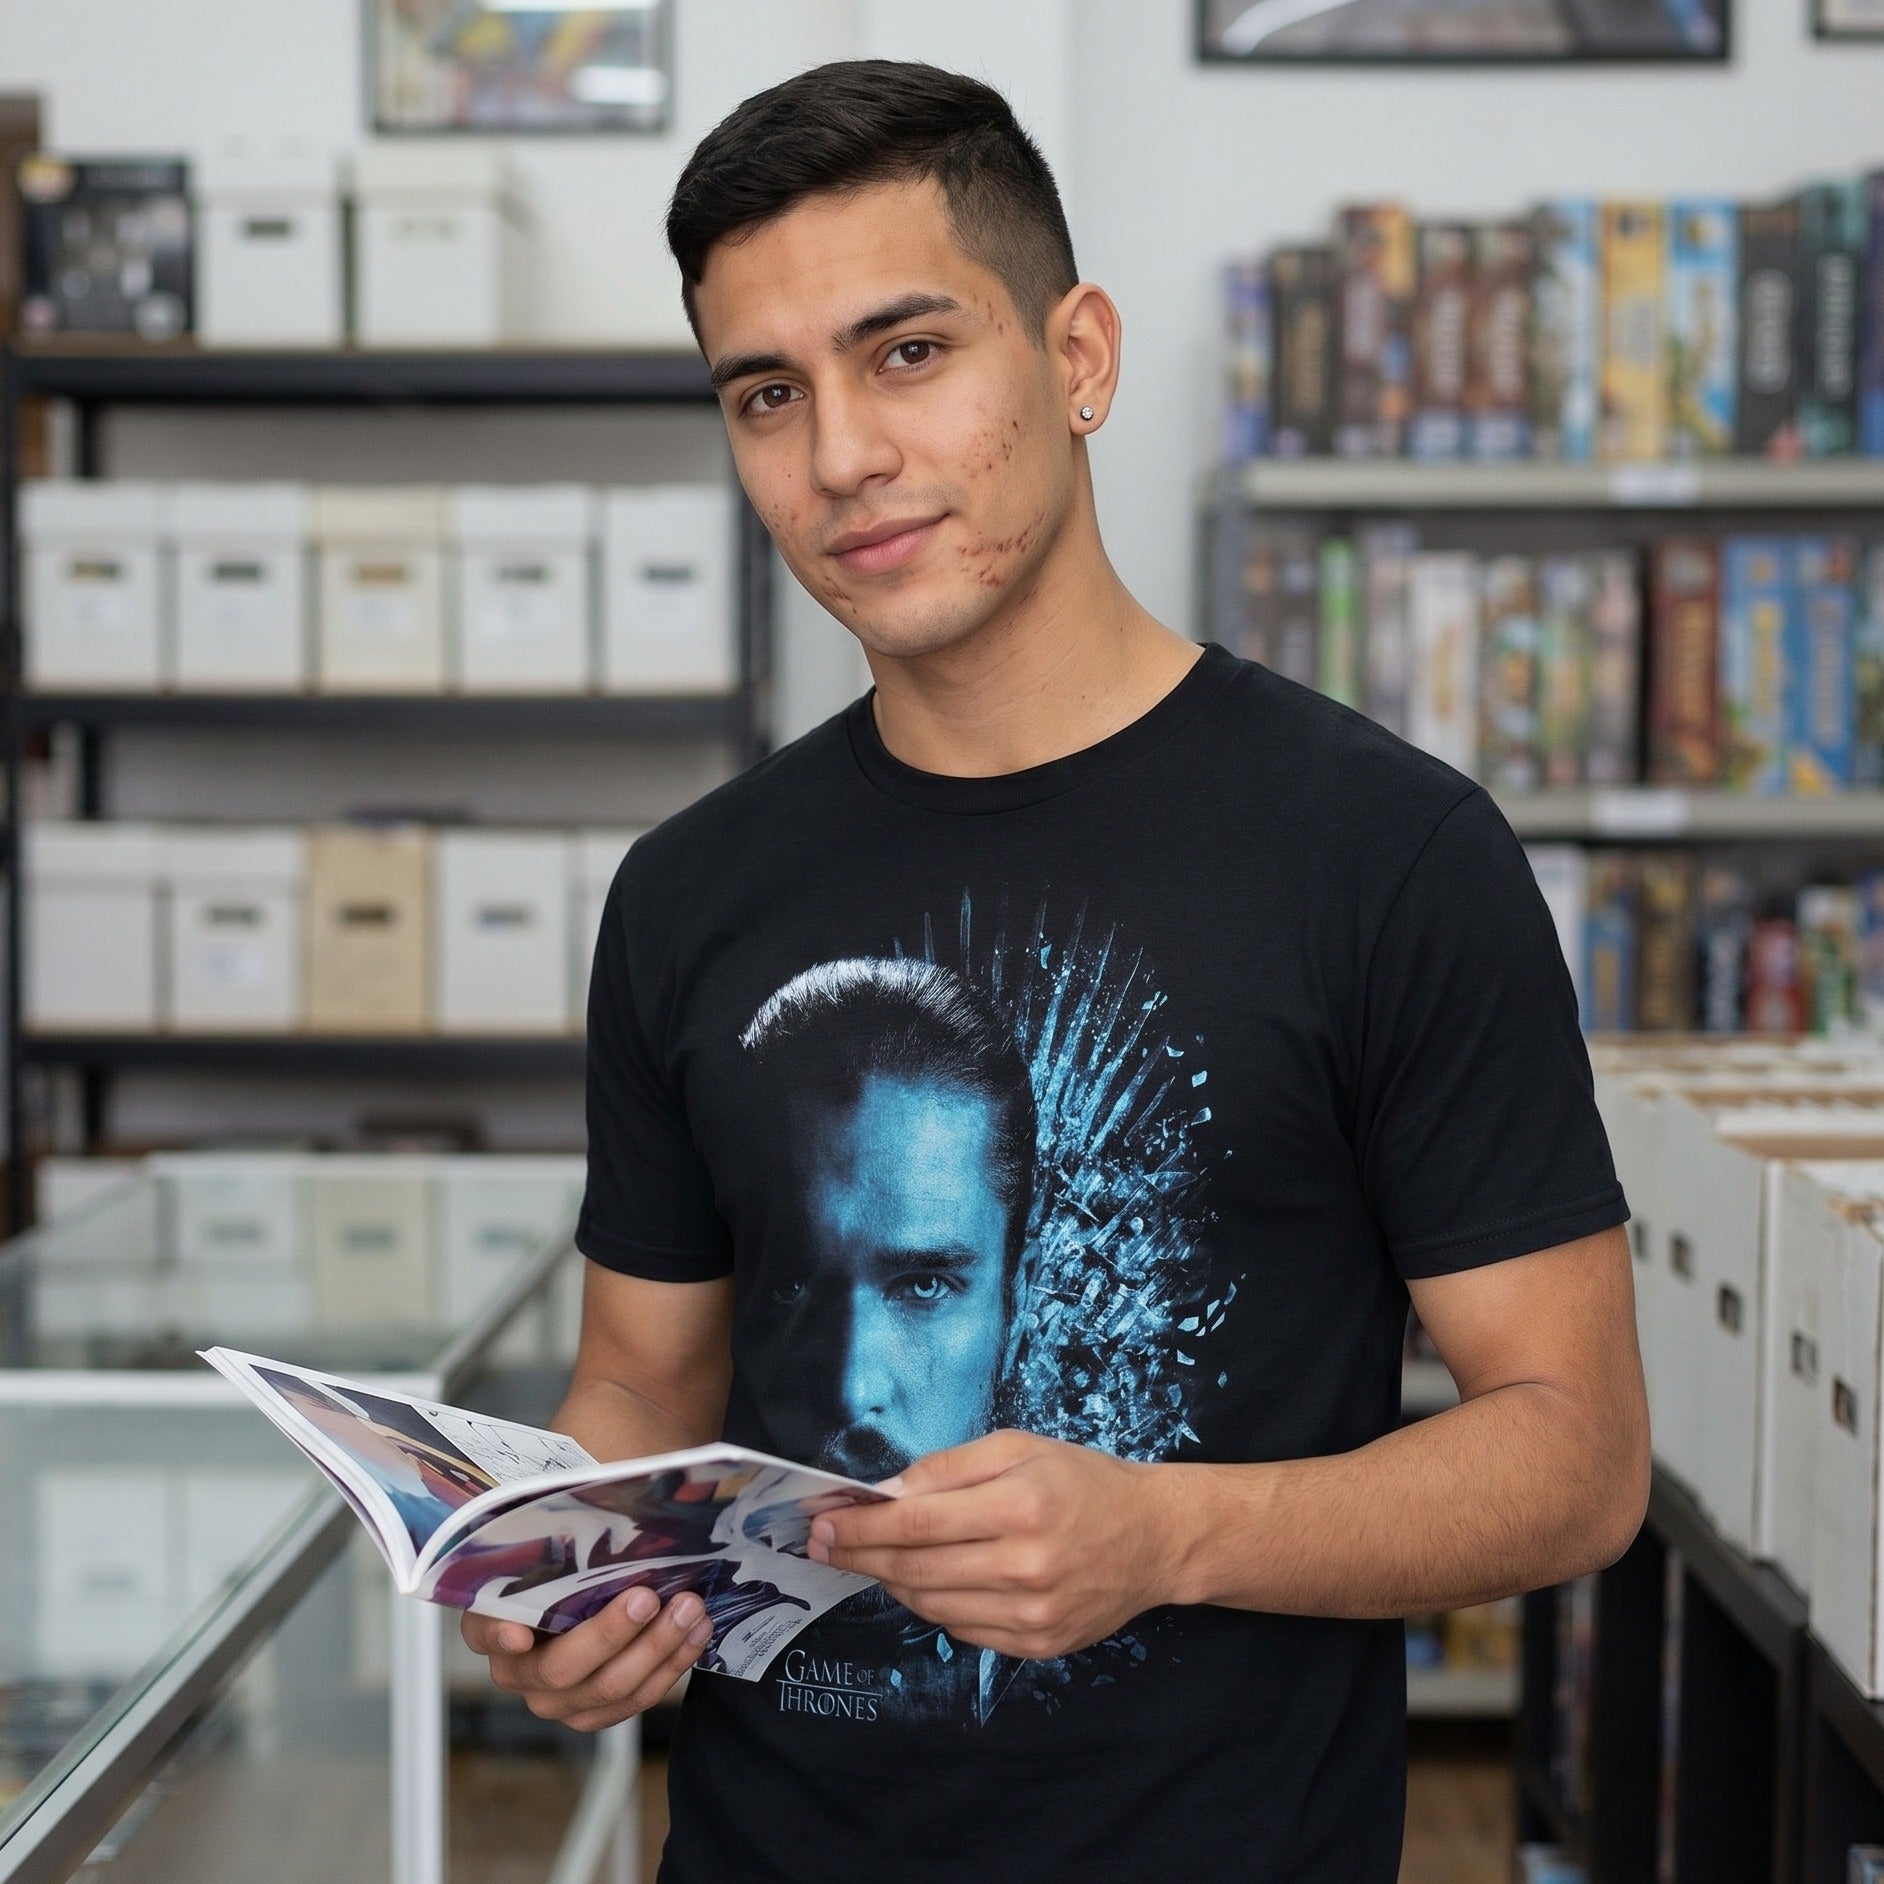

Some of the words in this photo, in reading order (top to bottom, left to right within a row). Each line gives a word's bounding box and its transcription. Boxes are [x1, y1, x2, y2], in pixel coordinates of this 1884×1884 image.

[785, 1650, 853, 1686] GAME
[856, 1668, 875, 1685] OF
[778, 1680, 879, 1722] THRONES
